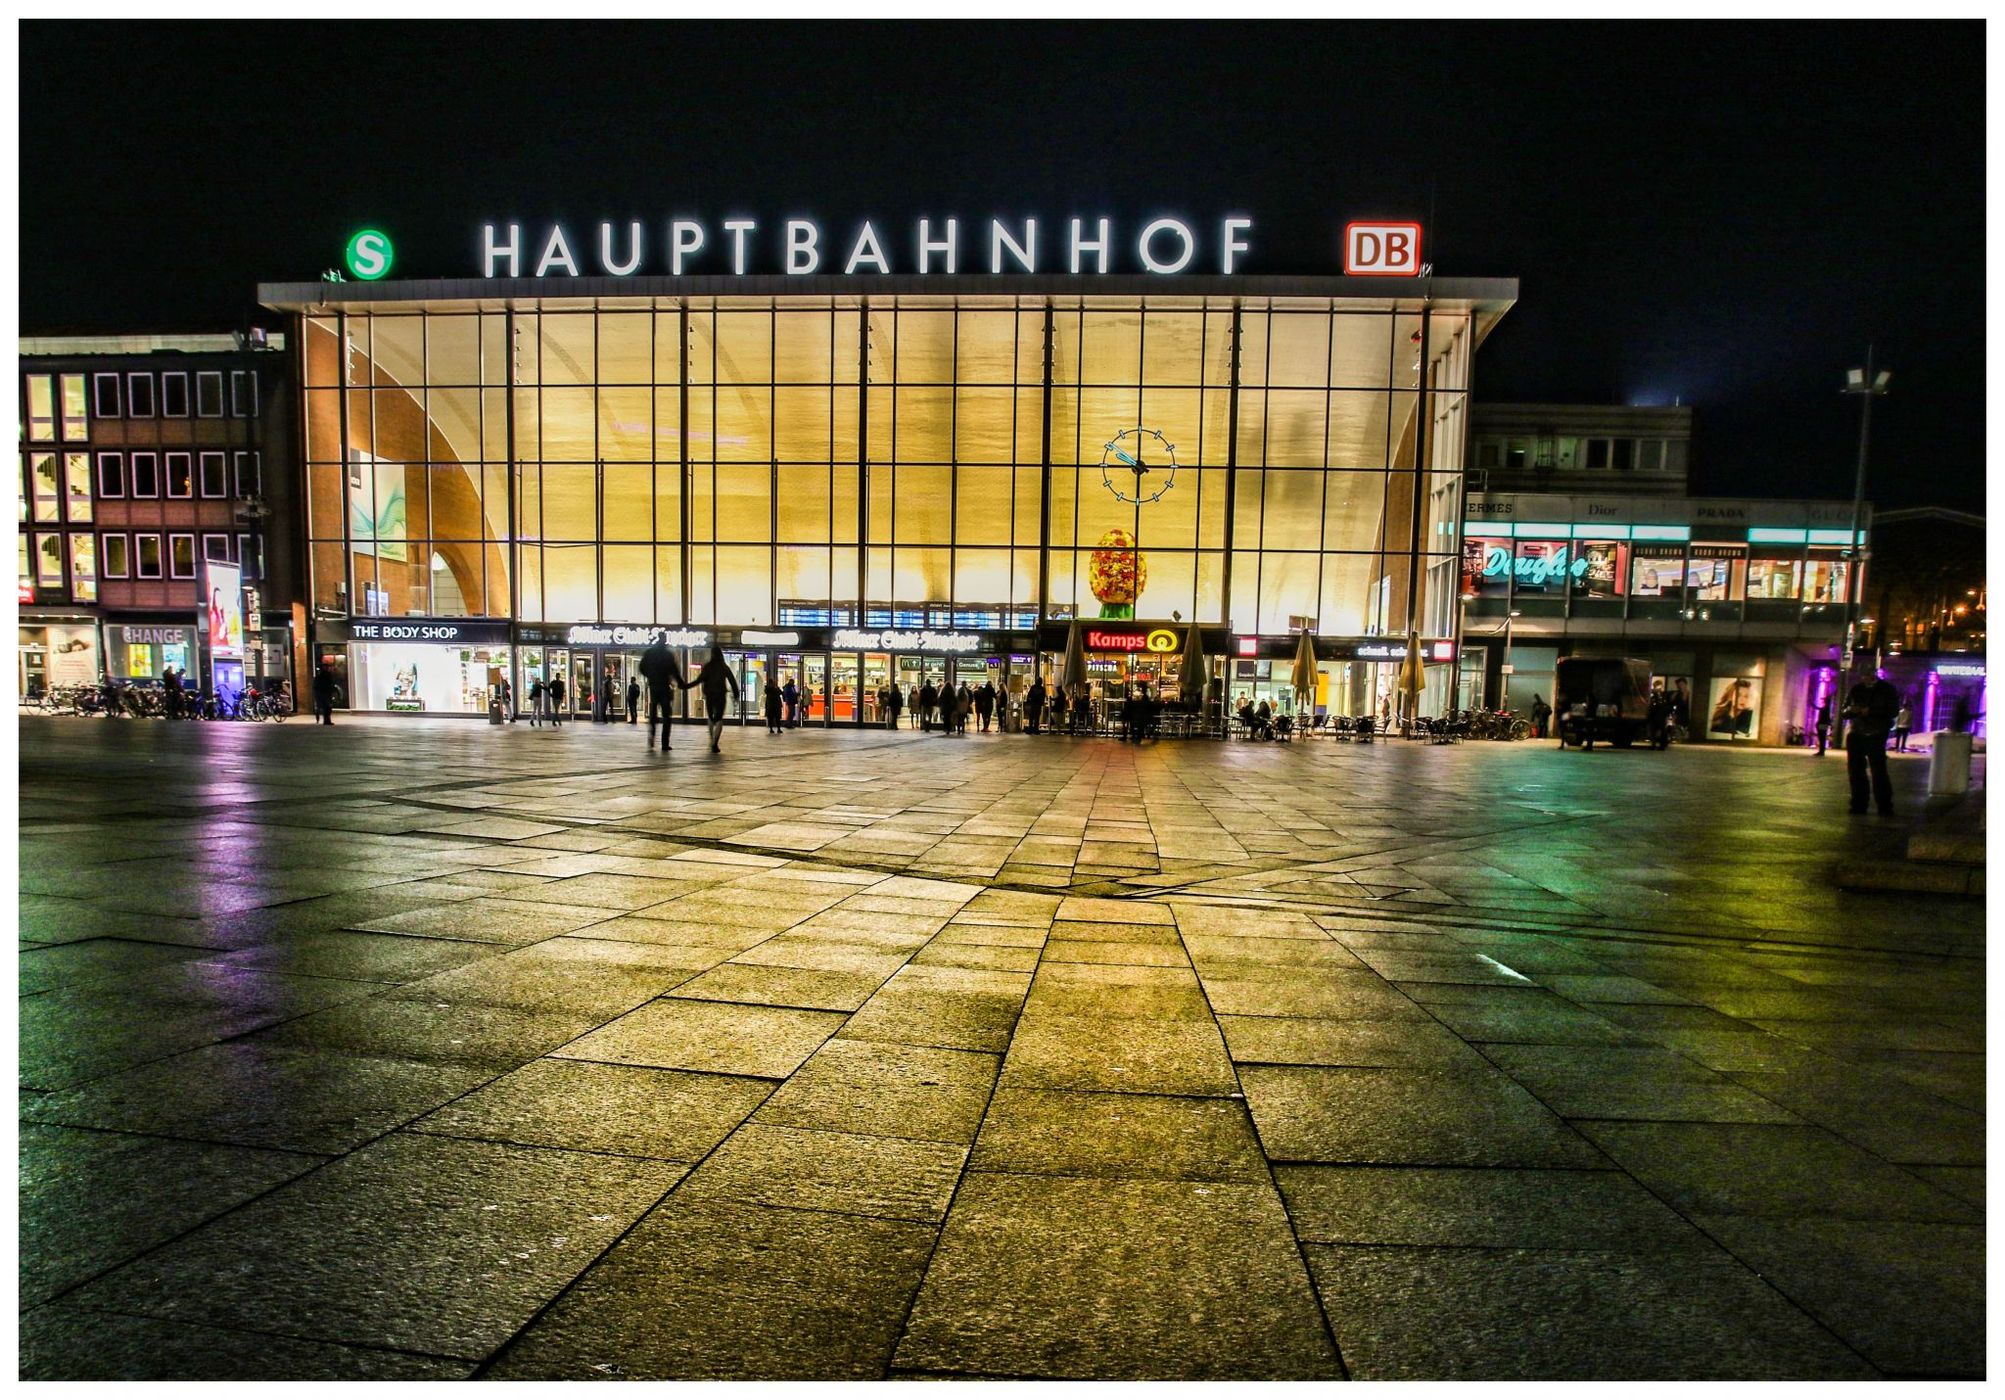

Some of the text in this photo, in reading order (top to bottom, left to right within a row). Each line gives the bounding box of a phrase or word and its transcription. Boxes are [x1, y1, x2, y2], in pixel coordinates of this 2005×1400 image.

[354, 234, 386, 276] S
[484, 218, 1252, 278] HAUPTBAHNHOF
[1354, 231, 1410, 267] DB
[1588, 503, 1619, 516] Dior
[1697, 507, 1745, 519] PRADA
[123, 626, 183, 643] CHANGE
[353, 625, 458, 639] THE BODY SHOP
[1088, 631, 1146, 650] Kamps
